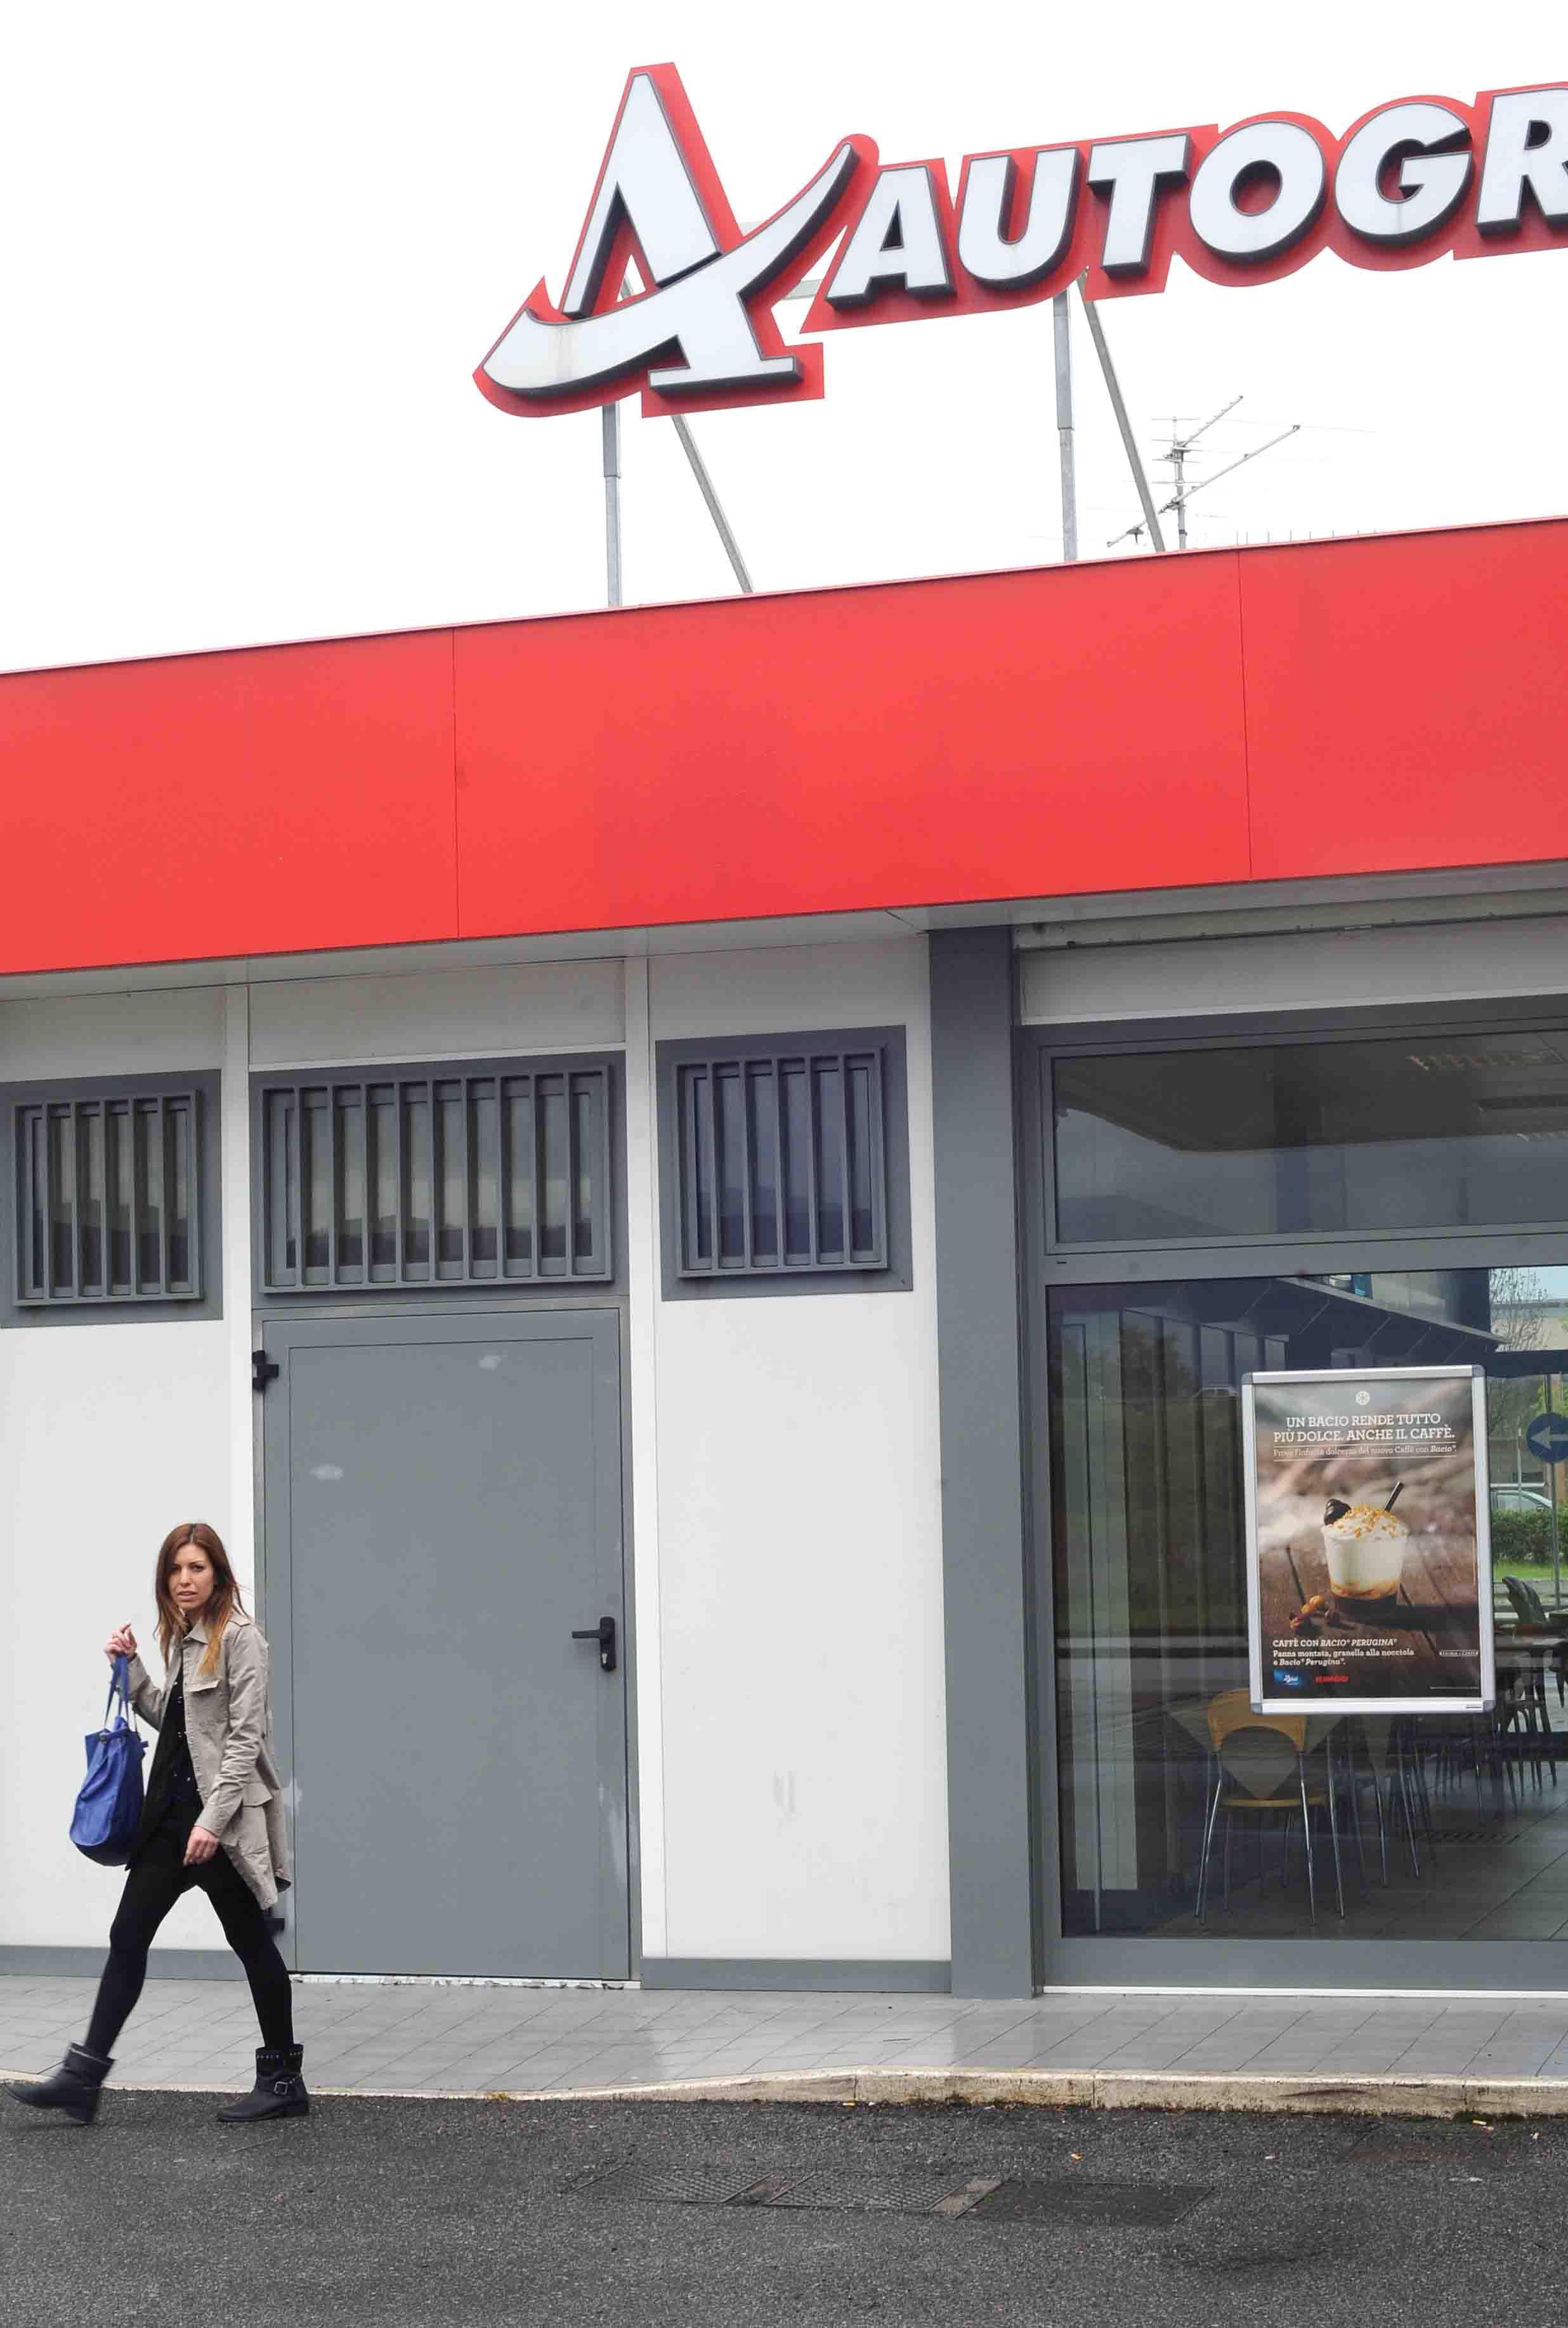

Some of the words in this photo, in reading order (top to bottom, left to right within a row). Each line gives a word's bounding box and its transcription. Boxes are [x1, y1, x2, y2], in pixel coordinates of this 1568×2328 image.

[1286, 1416, 1305, 1428] UN
[1307, 1415, 1349, 1427] BACIO
[1351, 1414, 1394, 1426] RENDE
[1396, 1413, 1441, 1424] TUTTO
[1273, 1428, 1294, 1442] PIÙ
[1297, 1430, 1344, 1442] DOLCE.
[1346, 1429, 1394, 1441] ANCHE
[1395, 1429, 1408, 1439] IL
[1410, 1423, 1455, 1439] CAFFÈ.
[1273, 1638, 1299, 1647] CAFFÈ
[1381, 1648, 1414, 1656] nocciola
